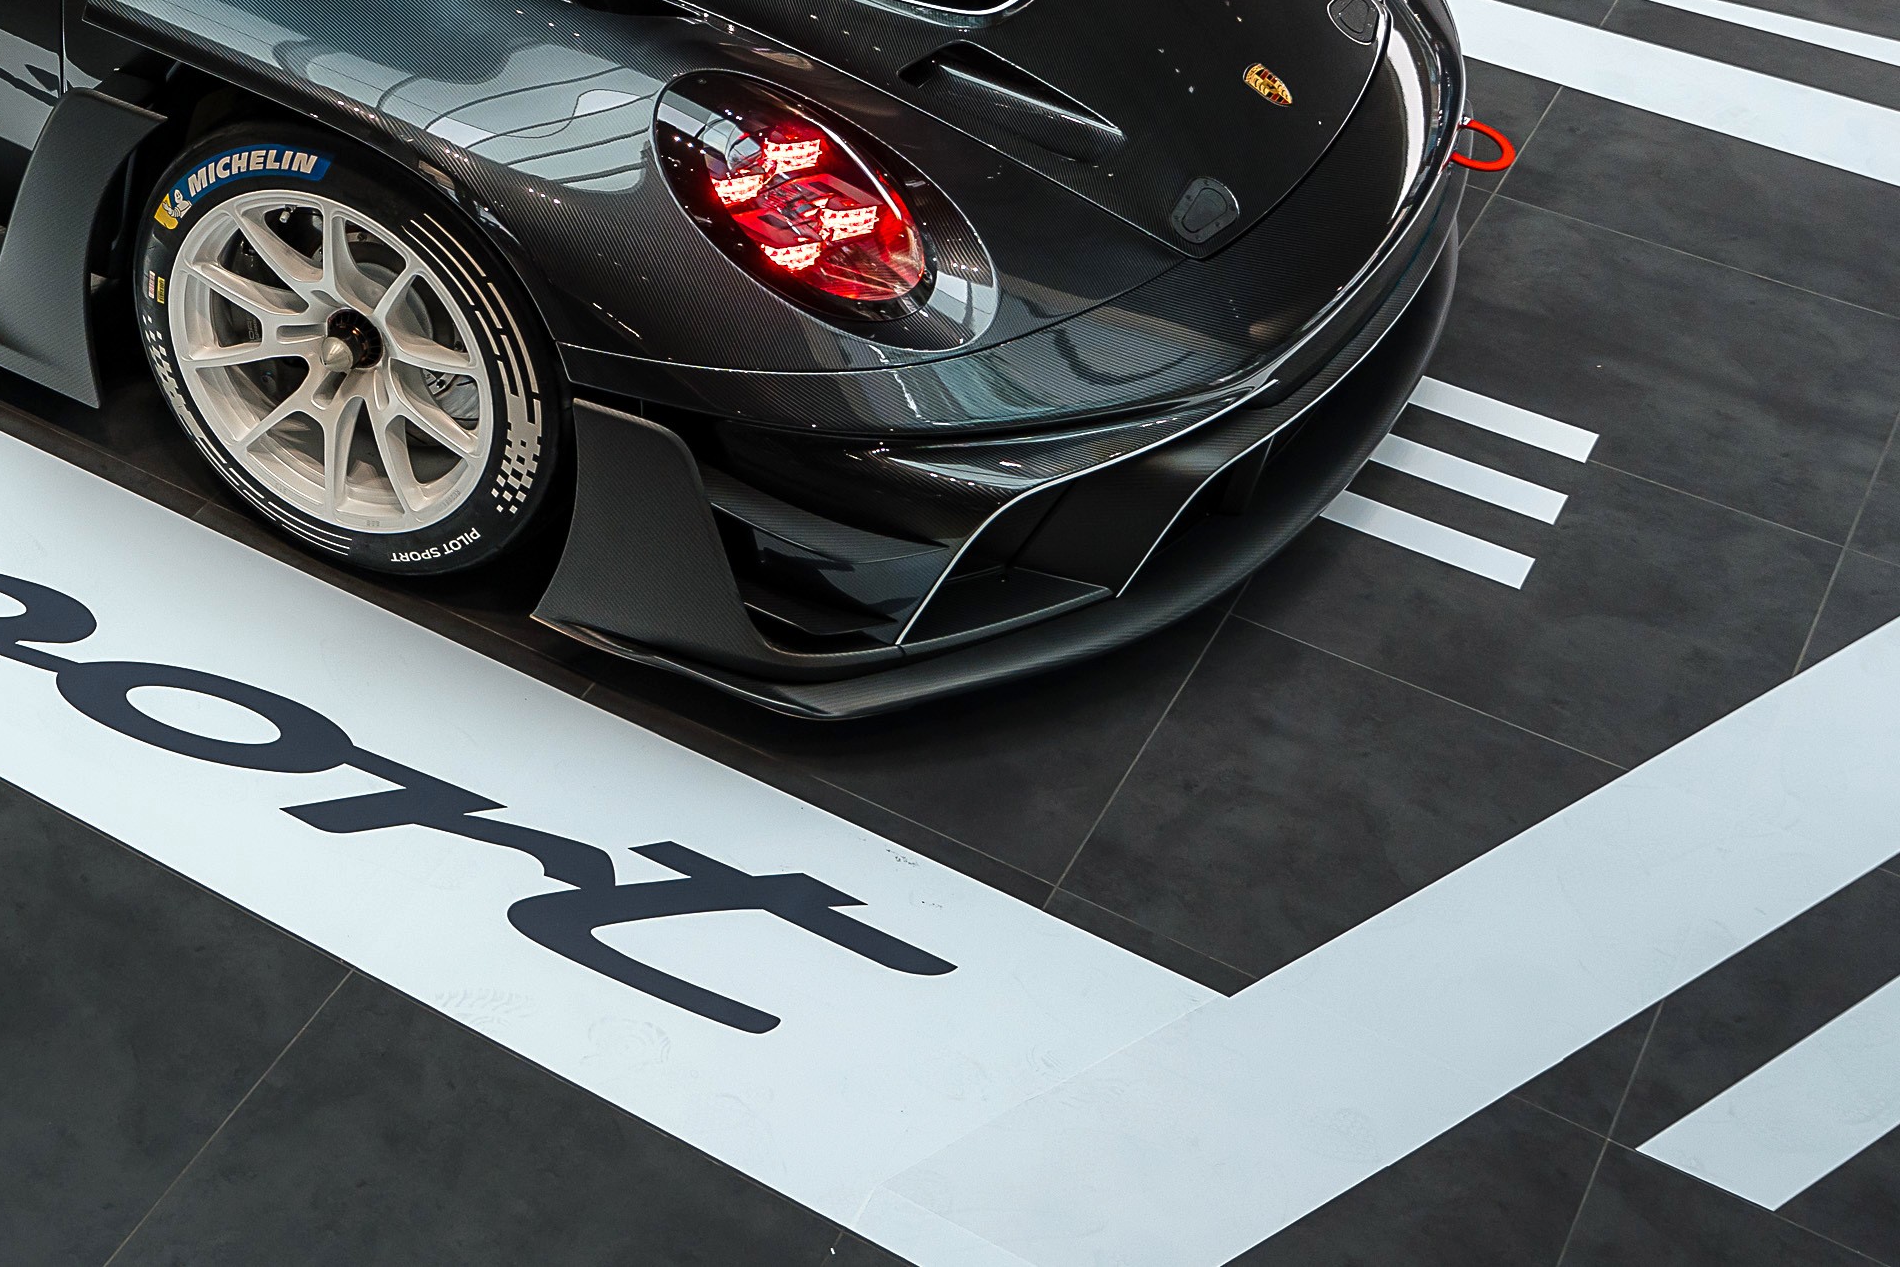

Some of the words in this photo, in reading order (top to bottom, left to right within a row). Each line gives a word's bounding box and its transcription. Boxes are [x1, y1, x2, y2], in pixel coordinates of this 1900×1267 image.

[187, 149, 318, 198] MICHELIN
[442, 527, 481, 554] PILOT
[390, 546, 441, 563] SPORT
